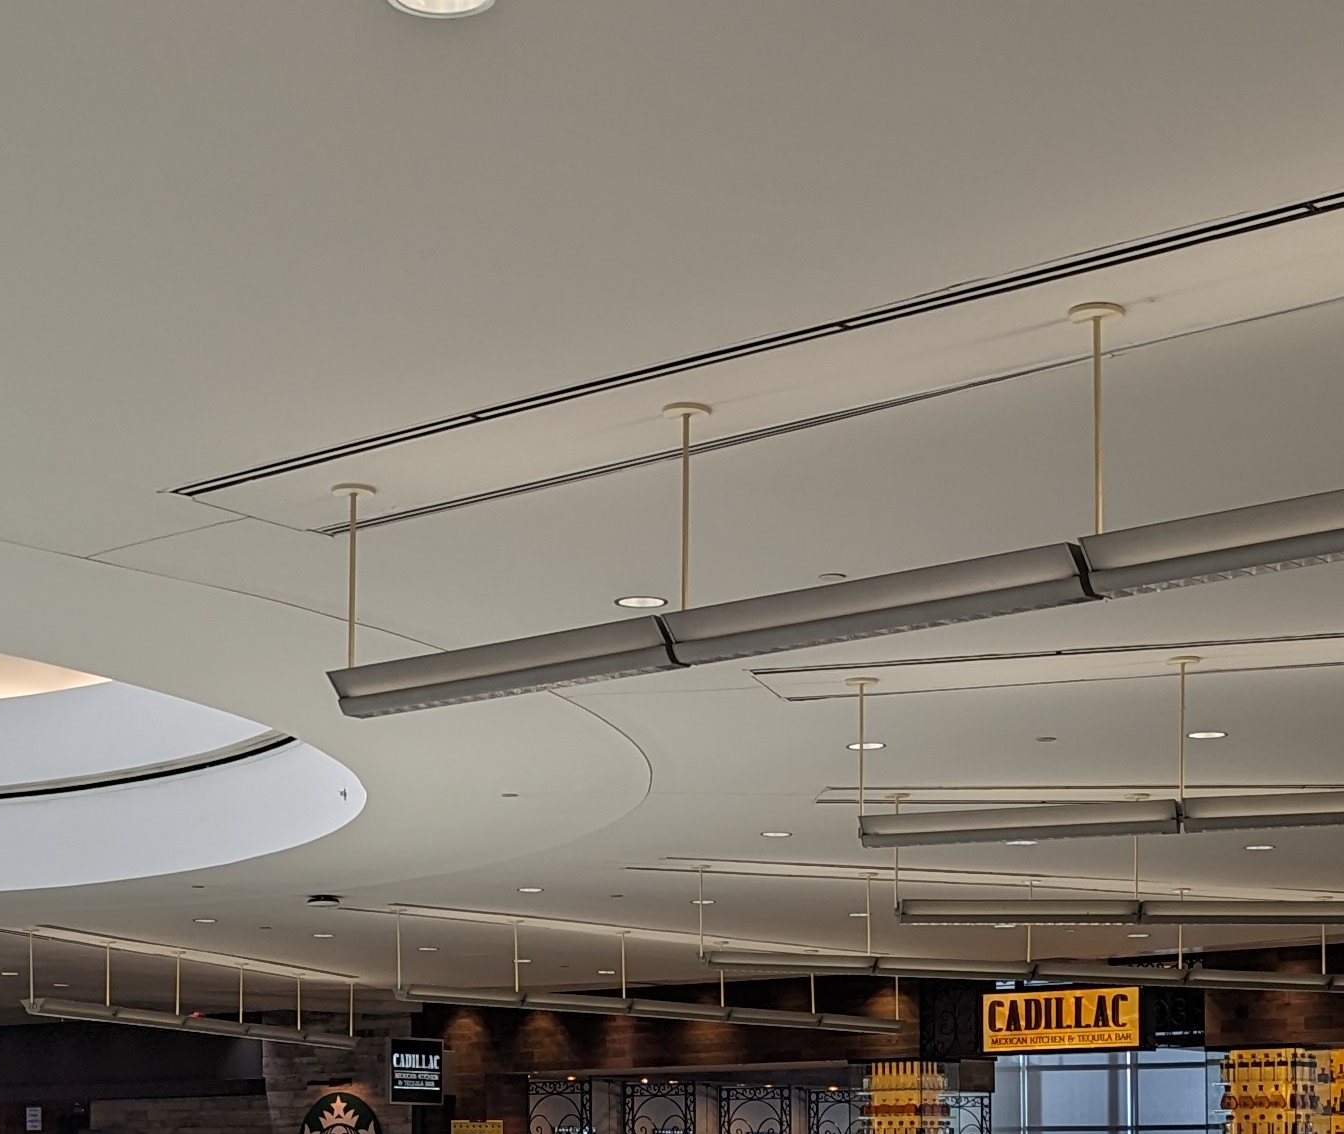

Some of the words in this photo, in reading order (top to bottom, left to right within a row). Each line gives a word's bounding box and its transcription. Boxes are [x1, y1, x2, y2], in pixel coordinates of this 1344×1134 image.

[988, 994, 1129, 1032] CADILLAC
[991, 1036, 1028, 1046] MEXICAN
[1030, 1035, 1066, 1044] KITCHEN
[1068, 1034, 1075, 1043] &
[1077, 1033, 1113, 1043] TEQUILA
[1115, 1032, 1132, 1041] BAR
[393, 1053, 440, 1069] CADILLAC
